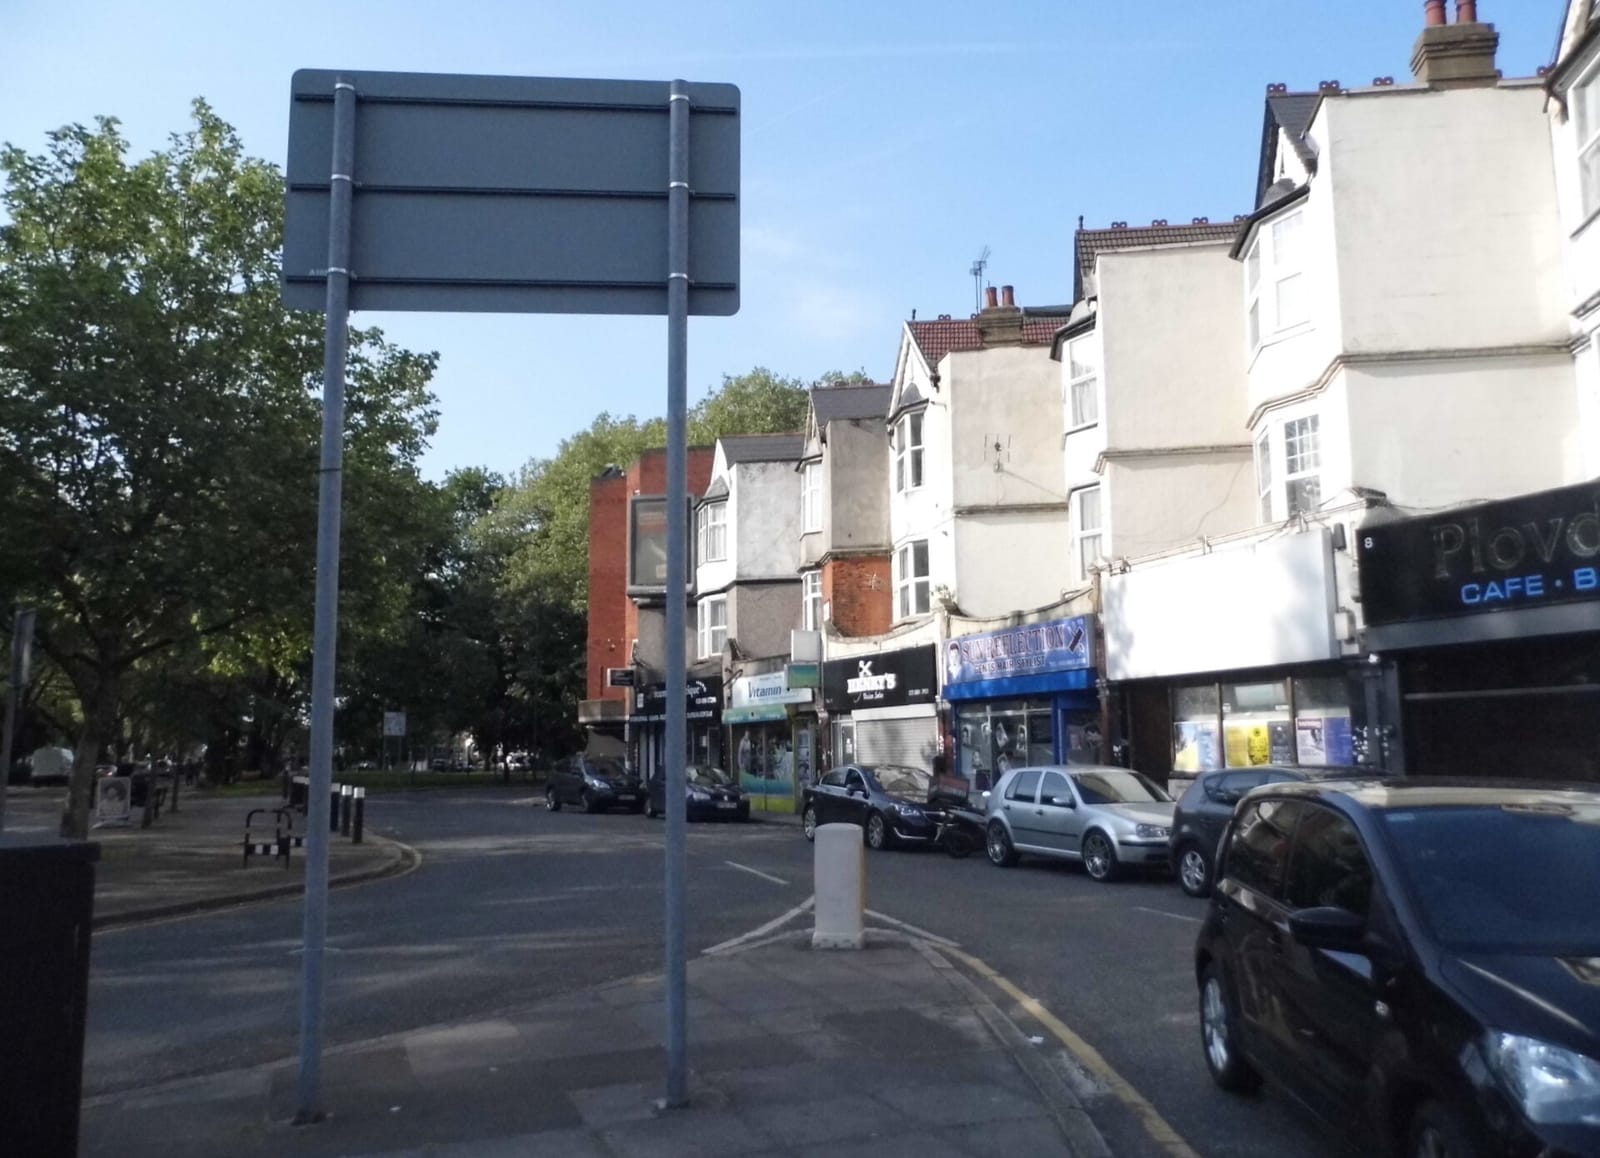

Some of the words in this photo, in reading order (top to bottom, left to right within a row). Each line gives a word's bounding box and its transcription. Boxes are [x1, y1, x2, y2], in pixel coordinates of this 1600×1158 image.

[1461, 575, 1544, 603] CAFE
[986, 625, 1064, 659] REFLECTION
[1016, 656, 1046, 668] STYLIST
[748, 681, 782, 698] Vitamin
